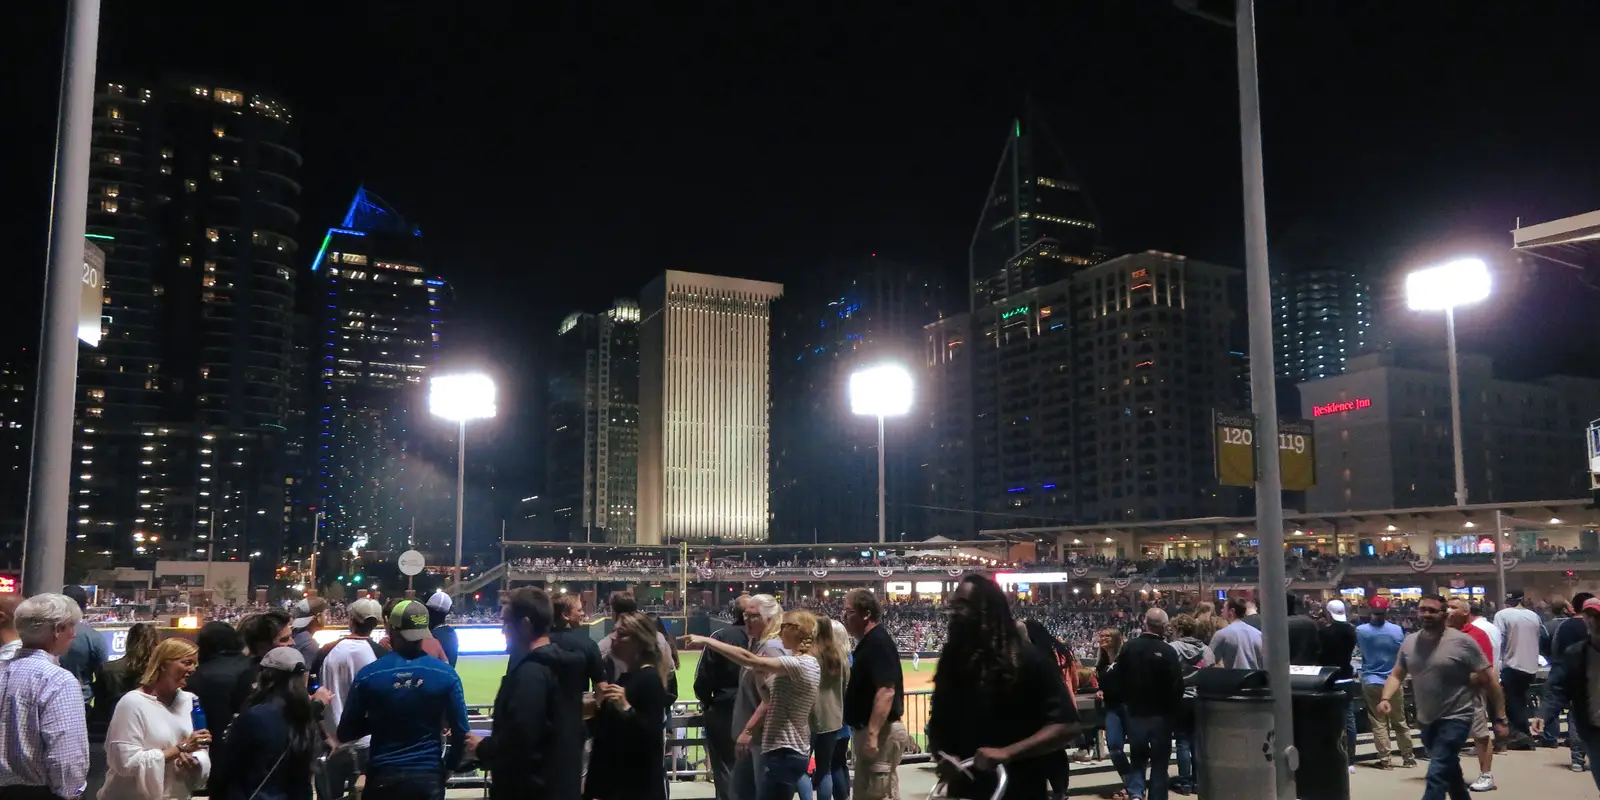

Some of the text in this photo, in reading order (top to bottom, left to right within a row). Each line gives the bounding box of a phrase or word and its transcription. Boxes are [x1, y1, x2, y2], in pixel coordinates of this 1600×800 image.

[81, 262, 97, 288] 20
[1313, 398, 1372, 416] Residence Inn
[1223, 427, 1253, 445] 120
[1279, 433, 1305, 454] 119
